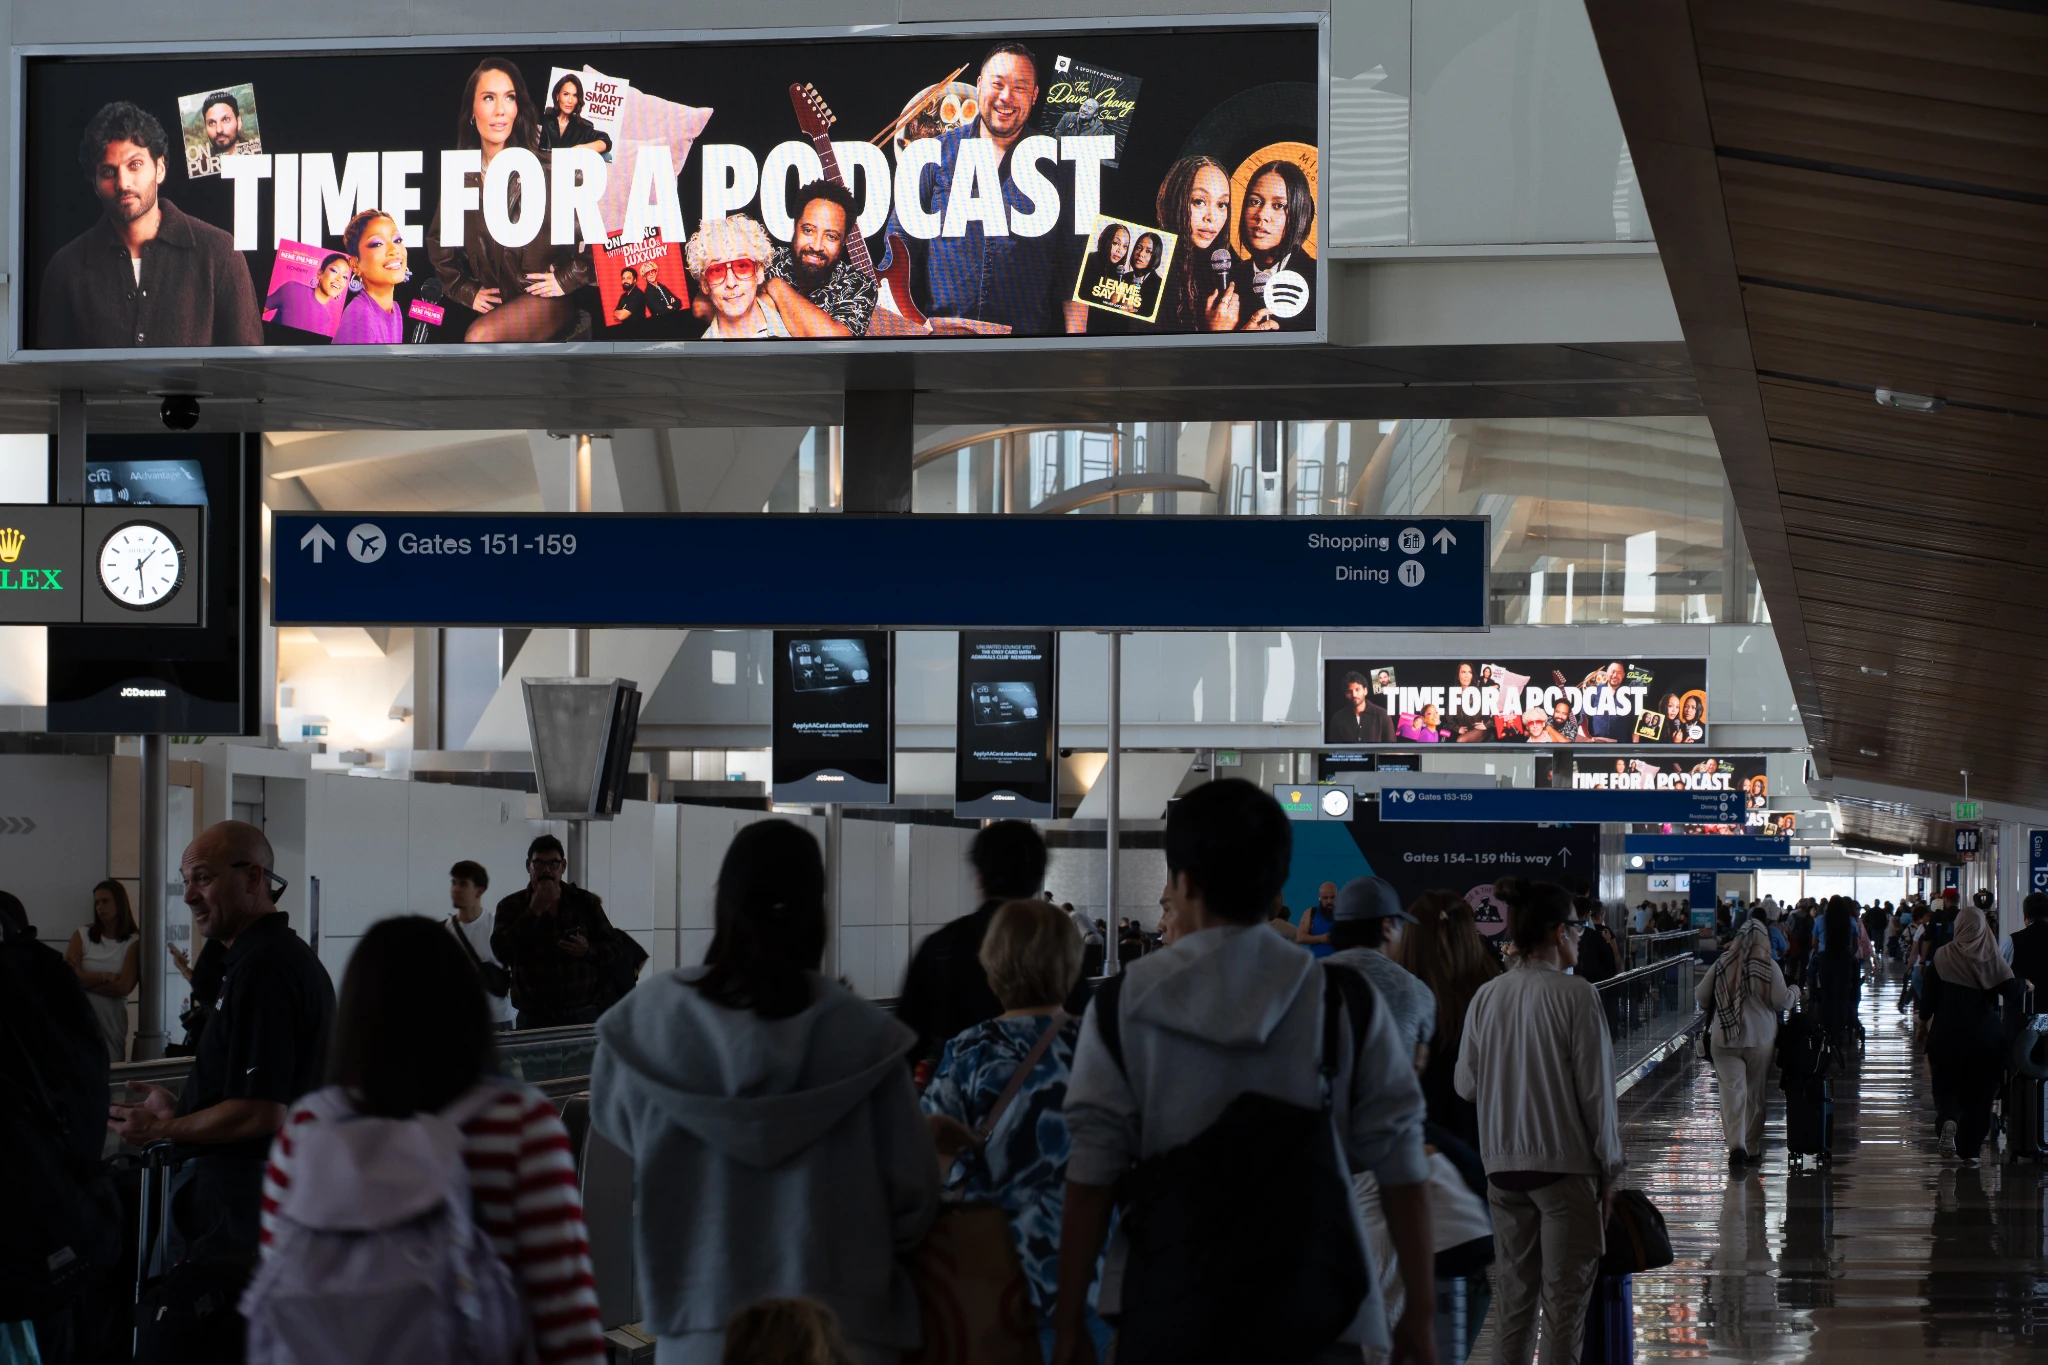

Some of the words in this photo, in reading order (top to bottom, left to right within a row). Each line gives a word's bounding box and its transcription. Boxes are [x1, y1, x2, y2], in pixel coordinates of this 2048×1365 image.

[1100, 73, 1122, 81] PODCAST
[594, 82, 617, 94] HOT
[1075, 81, 1090, 93] The
[585, 91, 624, 106] SMART
[1047, 83, 1088, 105] Dave
[1095, 88, 1135, 117] Chang
[589, 103, 615, 117] RICH
[1098, 109, 1118, 120] Show
[186, 143, 212, 161] ON
[221, 150, 424, 250] TIME
[440, 147, 611, 247] FOR
[620, 145, 686, 243] A
[702, 135, 1115, 241] PODCAST
[623, 237, 656, 257] DIALLO
[624, 244, 668, 267] LUXXURY
[1099, 276, 1141, 297] LEMME
[1092, 285, 1115, 299] SAY
[1117, 292, 1142, 308] THIS
[88, 468, 112, 482] citi
[130, 471, 181, 481] AAdvantage
[398, 532, 472, 555] Gates
[480, 533, 577, 555] 151-159
[1308, 533, 1390, 552] Shopping
[0, 569, 64, 591] LEX
[1335, 565, 1390, 585] Dining
[121, 687, 167, 697] JCDecaux
[1383, 686, 1445, 716] TIME
[1449, 686, 1500, 716] FOR
[1502, 686, 1523, 715] A
[1525, 686, 1648, 716] PODCAST
[1572, 772, 1609, 789] TIME
[1609, 772, 1642, 789] FOR
[1642, 772, 1656, 789] A
[1656, 772, 1732, 790] PODCAST
[1418, 792, 1442, 801] Gates
[1443, 792, 1473, 801] 153-159
[1692, 794, 1718, 802] Shopping
[1956, 803, 1977, 819] EXIT
[2034, 835, 2043, 858] Gate
[1402, 852, 1439, 863] Gates
[1499, 852, 1521, 863] this
[1524, 855, 1552, 866] way
[2034, 862, 2048, 893] 15
